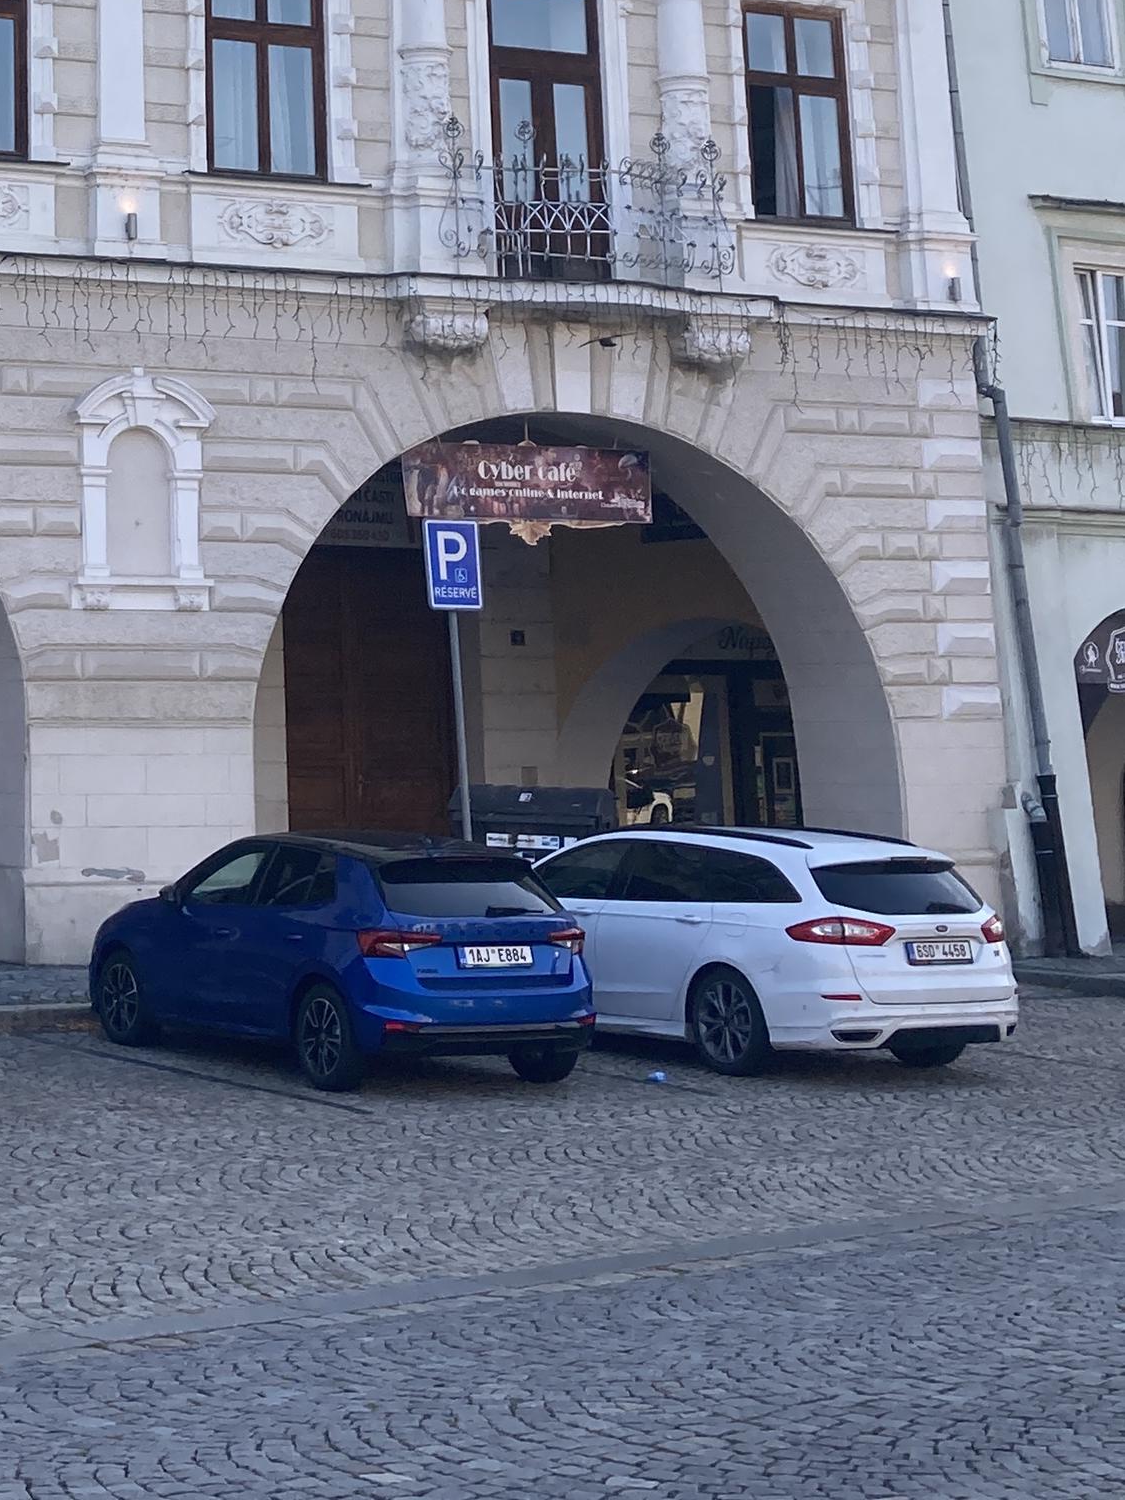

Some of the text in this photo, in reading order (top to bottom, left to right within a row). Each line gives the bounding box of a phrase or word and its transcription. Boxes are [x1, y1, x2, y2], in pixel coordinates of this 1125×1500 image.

[477, 459, 577, 482] Cyber café
[435, 530, 468, 581] P
[434, 585, 478, 599] RÉSERVÉ
[468, 948, 527, 963] 1AJ E884
[942, 944, 967, 958] 4458
